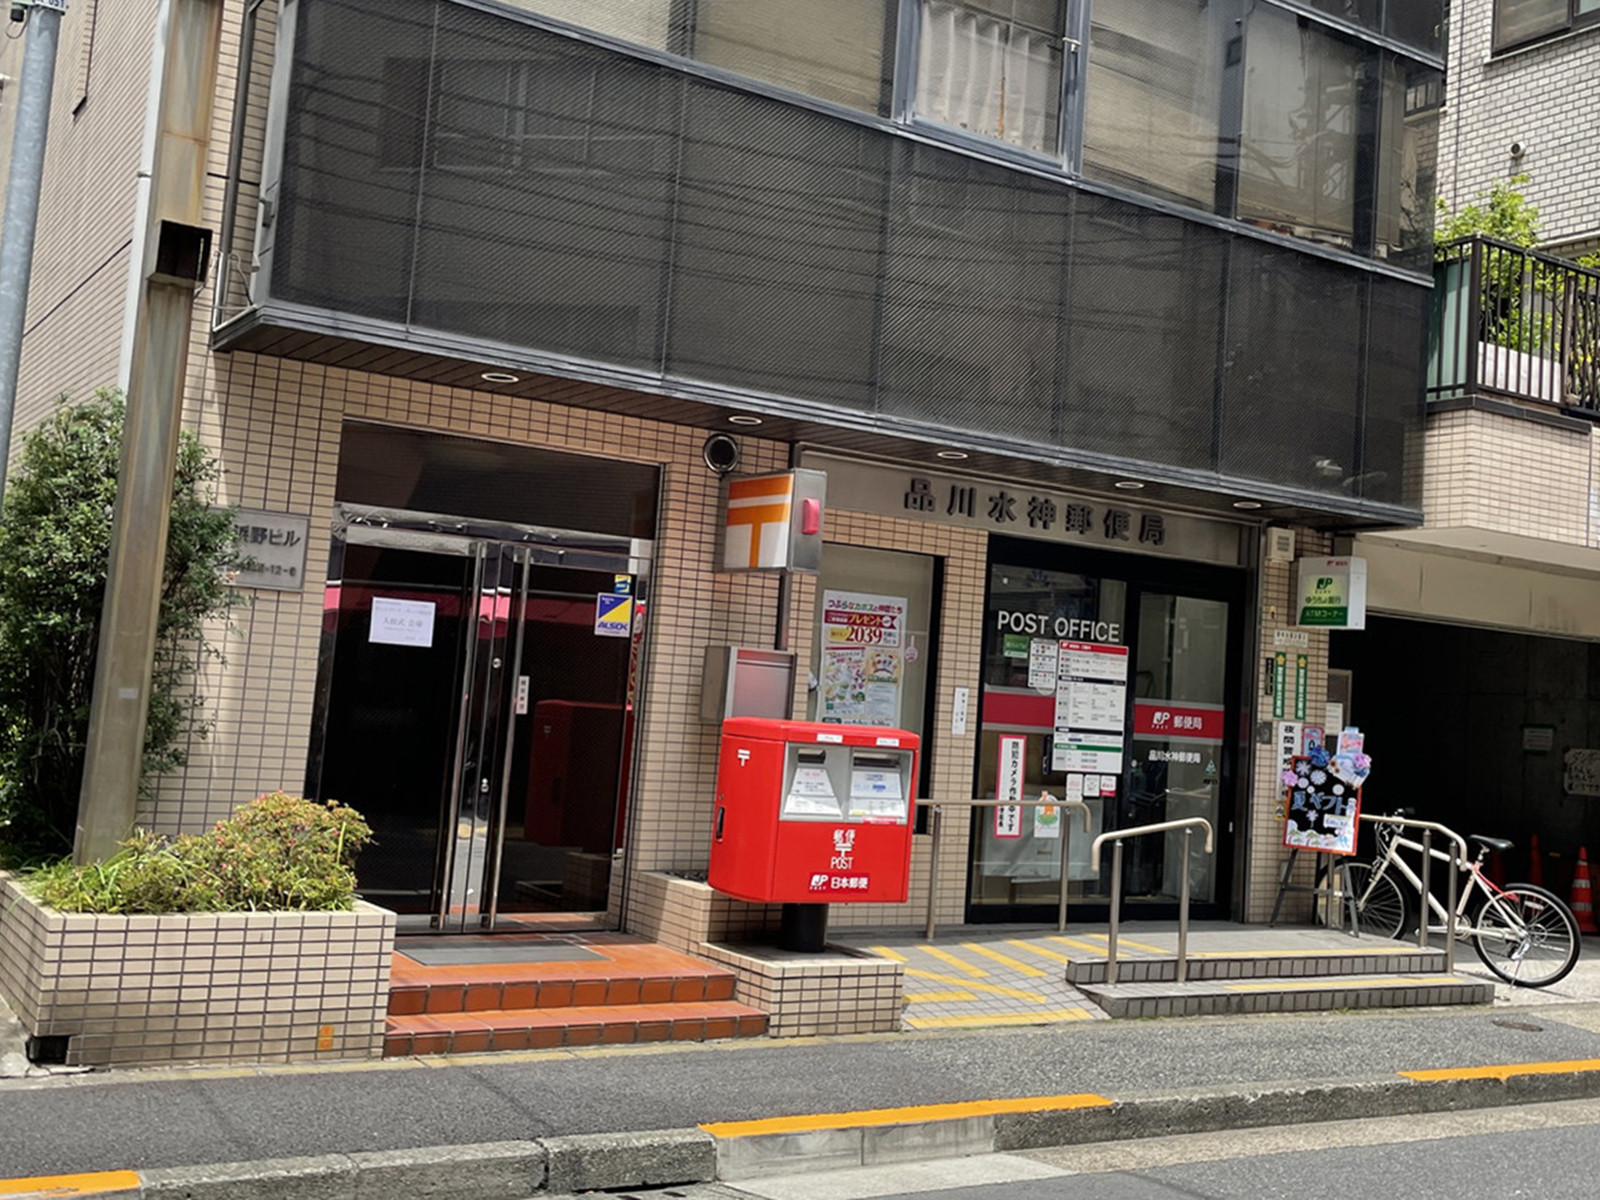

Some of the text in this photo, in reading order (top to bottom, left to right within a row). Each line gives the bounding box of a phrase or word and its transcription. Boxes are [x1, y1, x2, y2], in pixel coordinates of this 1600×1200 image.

[904, 478, 1166, 546] 品川水神郵便局
[1305, 595, 1342, 605] ゆうちょ銀行
[597, 621, 628, 631] ALSOK
[848, 613, 882, 626] プレゼント
[997, 609, 1121, 643] POST OFFICE
[845, 625, 883, 645] 2039
[1173, 715, 1203, 731] 郵便局
[1148, 749, 1202, 764] 品川水神郵便局
[833, 829, 856, 845] 郵便
[830, 856, 854, 870] POST
[831, 876, 869, 889] 日本郵便
